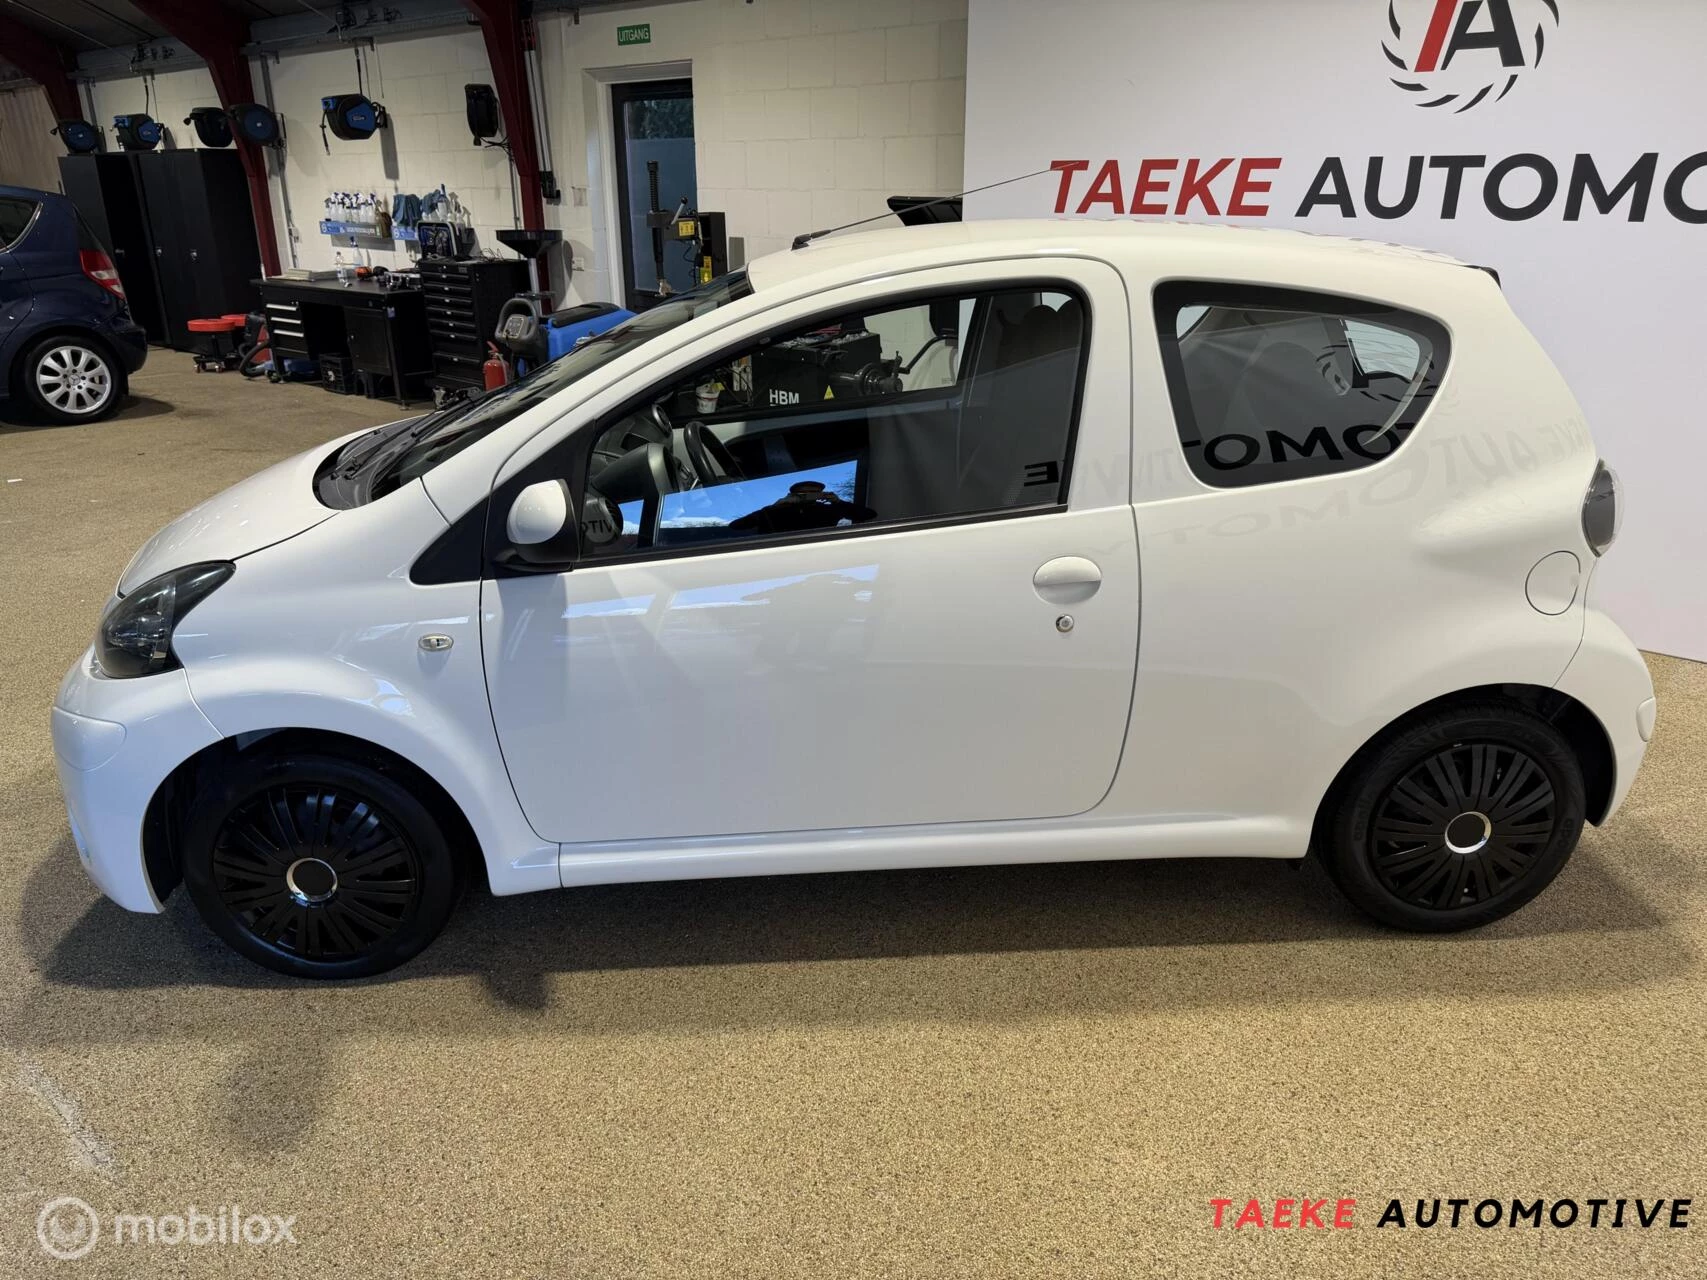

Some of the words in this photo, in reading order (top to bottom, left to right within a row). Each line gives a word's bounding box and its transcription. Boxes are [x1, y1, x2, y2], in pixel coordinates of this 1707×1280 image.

[618, 27, 649, 42] UITGANG
[1050, 157, 1282, 216] TAEKE
[769, 389, 799, 405] HBM
